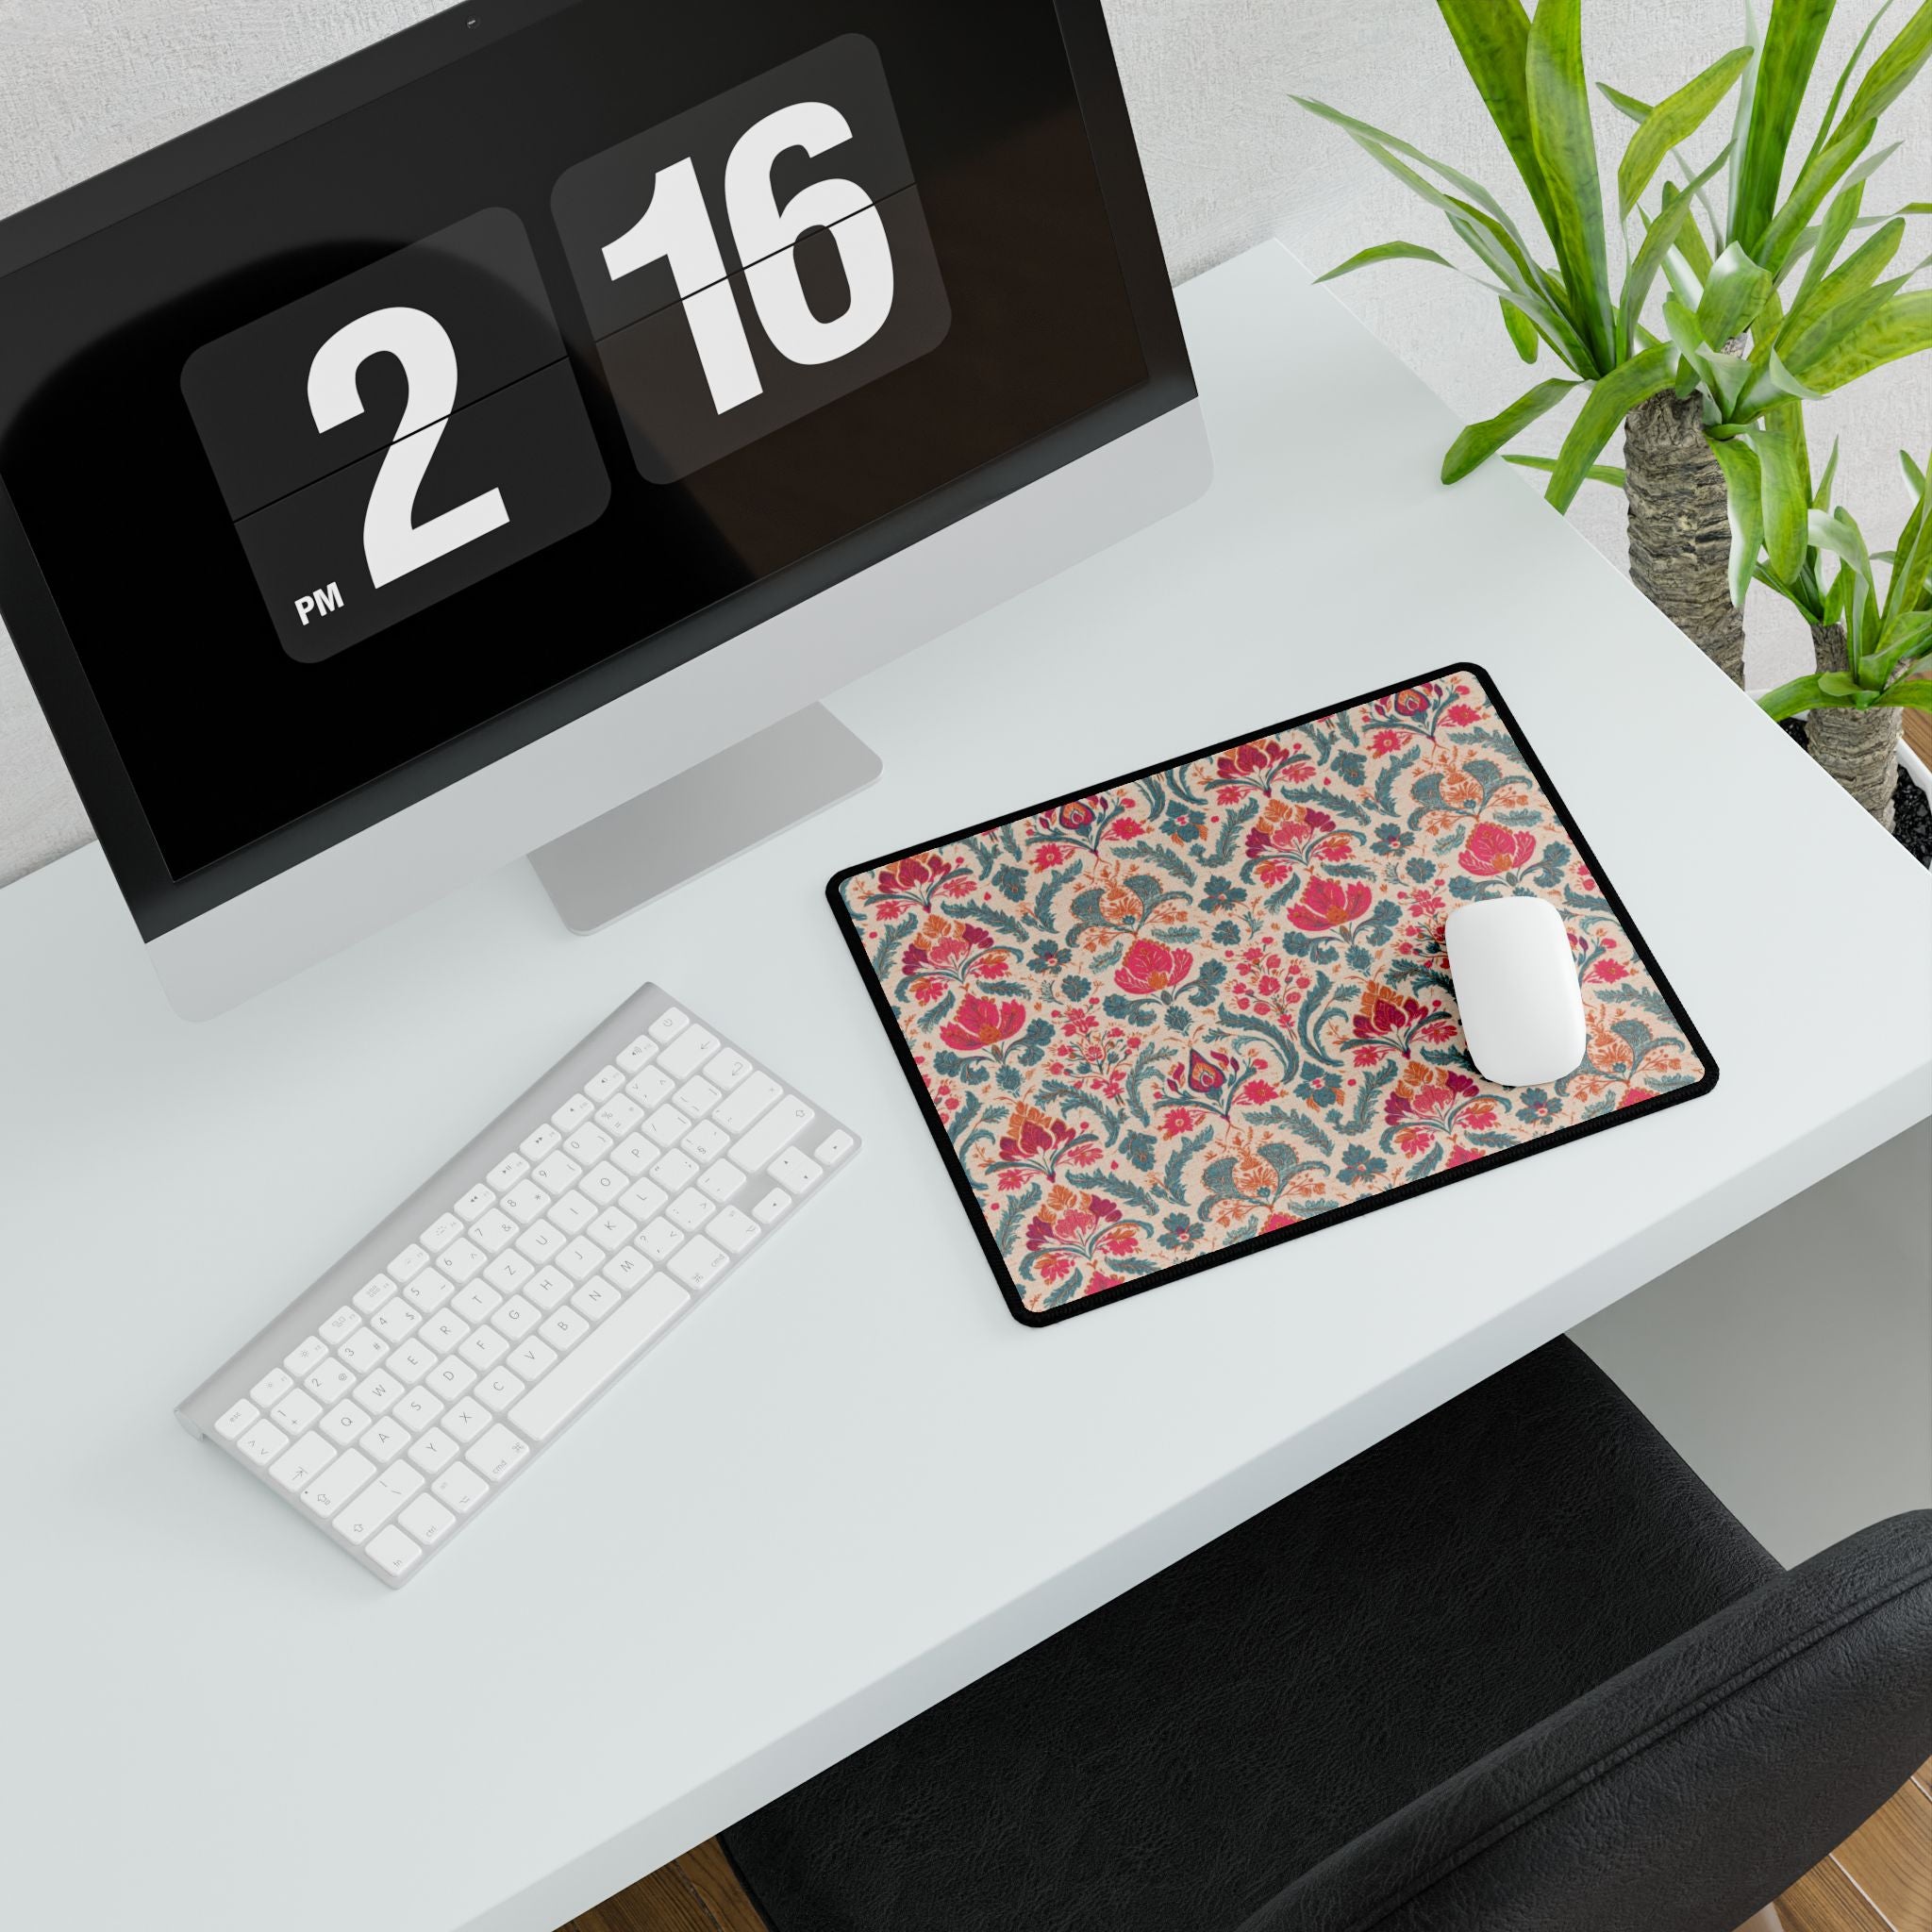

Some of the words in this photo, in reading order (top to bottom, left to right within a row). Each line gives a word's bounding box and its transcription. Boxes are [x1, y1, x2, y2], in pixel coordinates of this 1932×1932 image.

[308, 308, 509, 589] 2
[602, 102, 893, 414] 16
[295, 582, 343, 625] PM
[310, 1377, 323, 1388] 2
[344, 1347, 355, 1357] 3
[379, 1316, 388, 1326] 4
[410, 1287, 422, 1297] 5
[443, 1257, 453, 1268] 6
[474, 1227, 483, 1238] 7
[507, 1199, 517, 1208] 8
[539, 1170, 548, 1178] 9
[341, 1417, 354, 1427] Q
[371, 1384, 386, 1397] W
[407, 1355, 419, 1366] E
[439, 1325, 451, 1335] R
[471, 1294, 483, 1304] T
[504, 1264, 517, 1276] Z
[535, 1235, 550, 1246] U
[598, 1177, 611, 1187] O
[630, 1148, 641, 1158] P
[378, 1433, 391, 1444] A
[410, 1401, 423, 1411] S
[442, 1371, 455, 1381] D
[475, 1340, 486, 1350] F
[508, 1309, 521, 1320] G
[539, 1278, 554, 1291] H
[574, 1250, 584, 1260] J
[604, 1221, 616, 1231] K
[636, 1193, 648, 1202] L
[425, 1442, 437, 1453] Y
[458, 1411, 473, 1424] X
[491, 1381, 505, 1391] C
[524, 1350, 535, 1360] V
[557, 1321, 569, 1331] B
[588, 1290, 602, 1302] N
[620, 1259, 635, 1273] M
